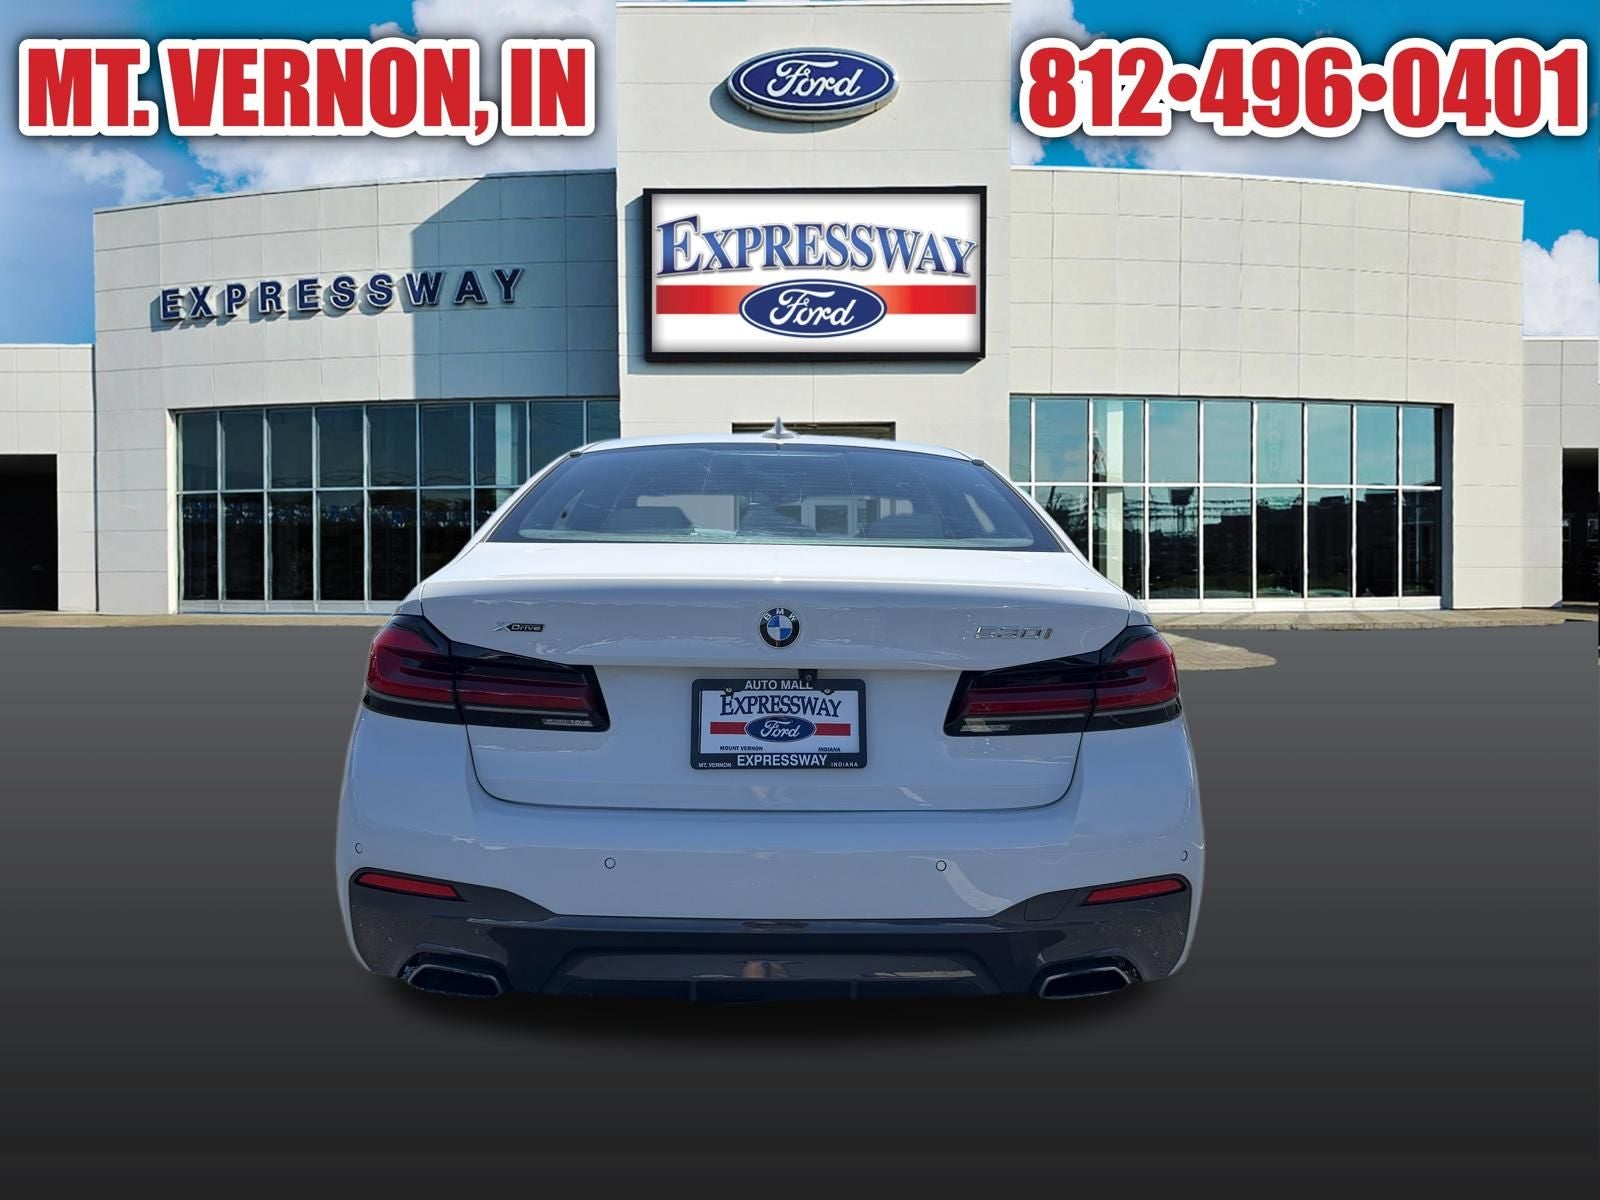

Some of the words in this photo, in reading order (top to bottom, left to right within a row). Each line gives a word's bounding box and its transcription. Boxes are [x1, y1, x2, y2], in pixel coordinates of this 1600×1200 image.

[766, 59, 864, 98] Ford
[159, 268, 525, 322] EXPRESSWAY
[769, 289, 856, 326] Ford
[745, 680, 777, 690] AUTO
[781, 680, 813, 690] MALL
[760, 719, 800, 738] Ford
[737, 754, 828, 767] EXPRESSWAY
